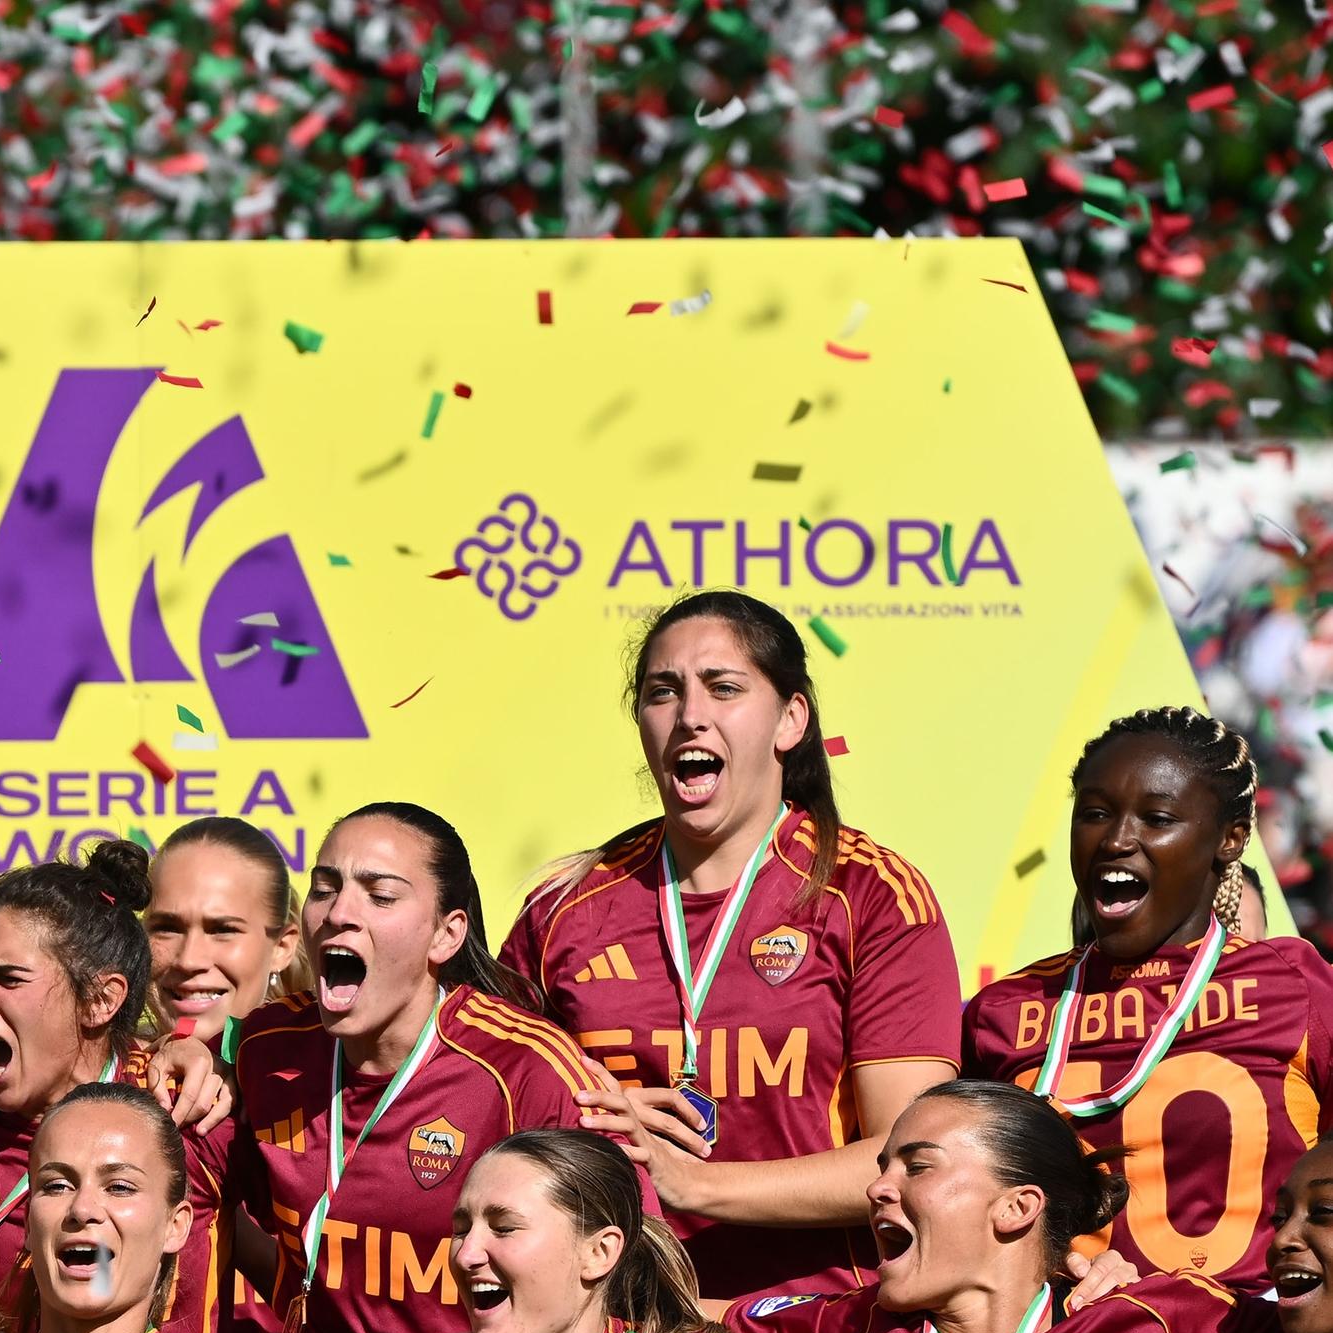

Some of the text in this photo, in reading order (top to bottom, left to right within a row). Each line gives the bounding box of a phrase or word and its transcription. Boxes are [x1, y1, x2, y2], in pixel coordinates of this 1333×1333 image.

[607, 518, 1023, 589] ATHORA
[616, 605, 665, 619] TUO
[794, 604, 812, 618] IN
[820, 604, 974, 619] ASSICURAZIONI
[981, 603, 1023, 617] VITA
[240, 769, 296, 817] A
[755, 956, 797, 968] ROMA
[651, 1026, 809, 1098] TIM
[413, 1156, 452, 1171] ROMA
[420, 1171, 437, 1180] 1927
[318, 1217, 460, 1306] TIM
